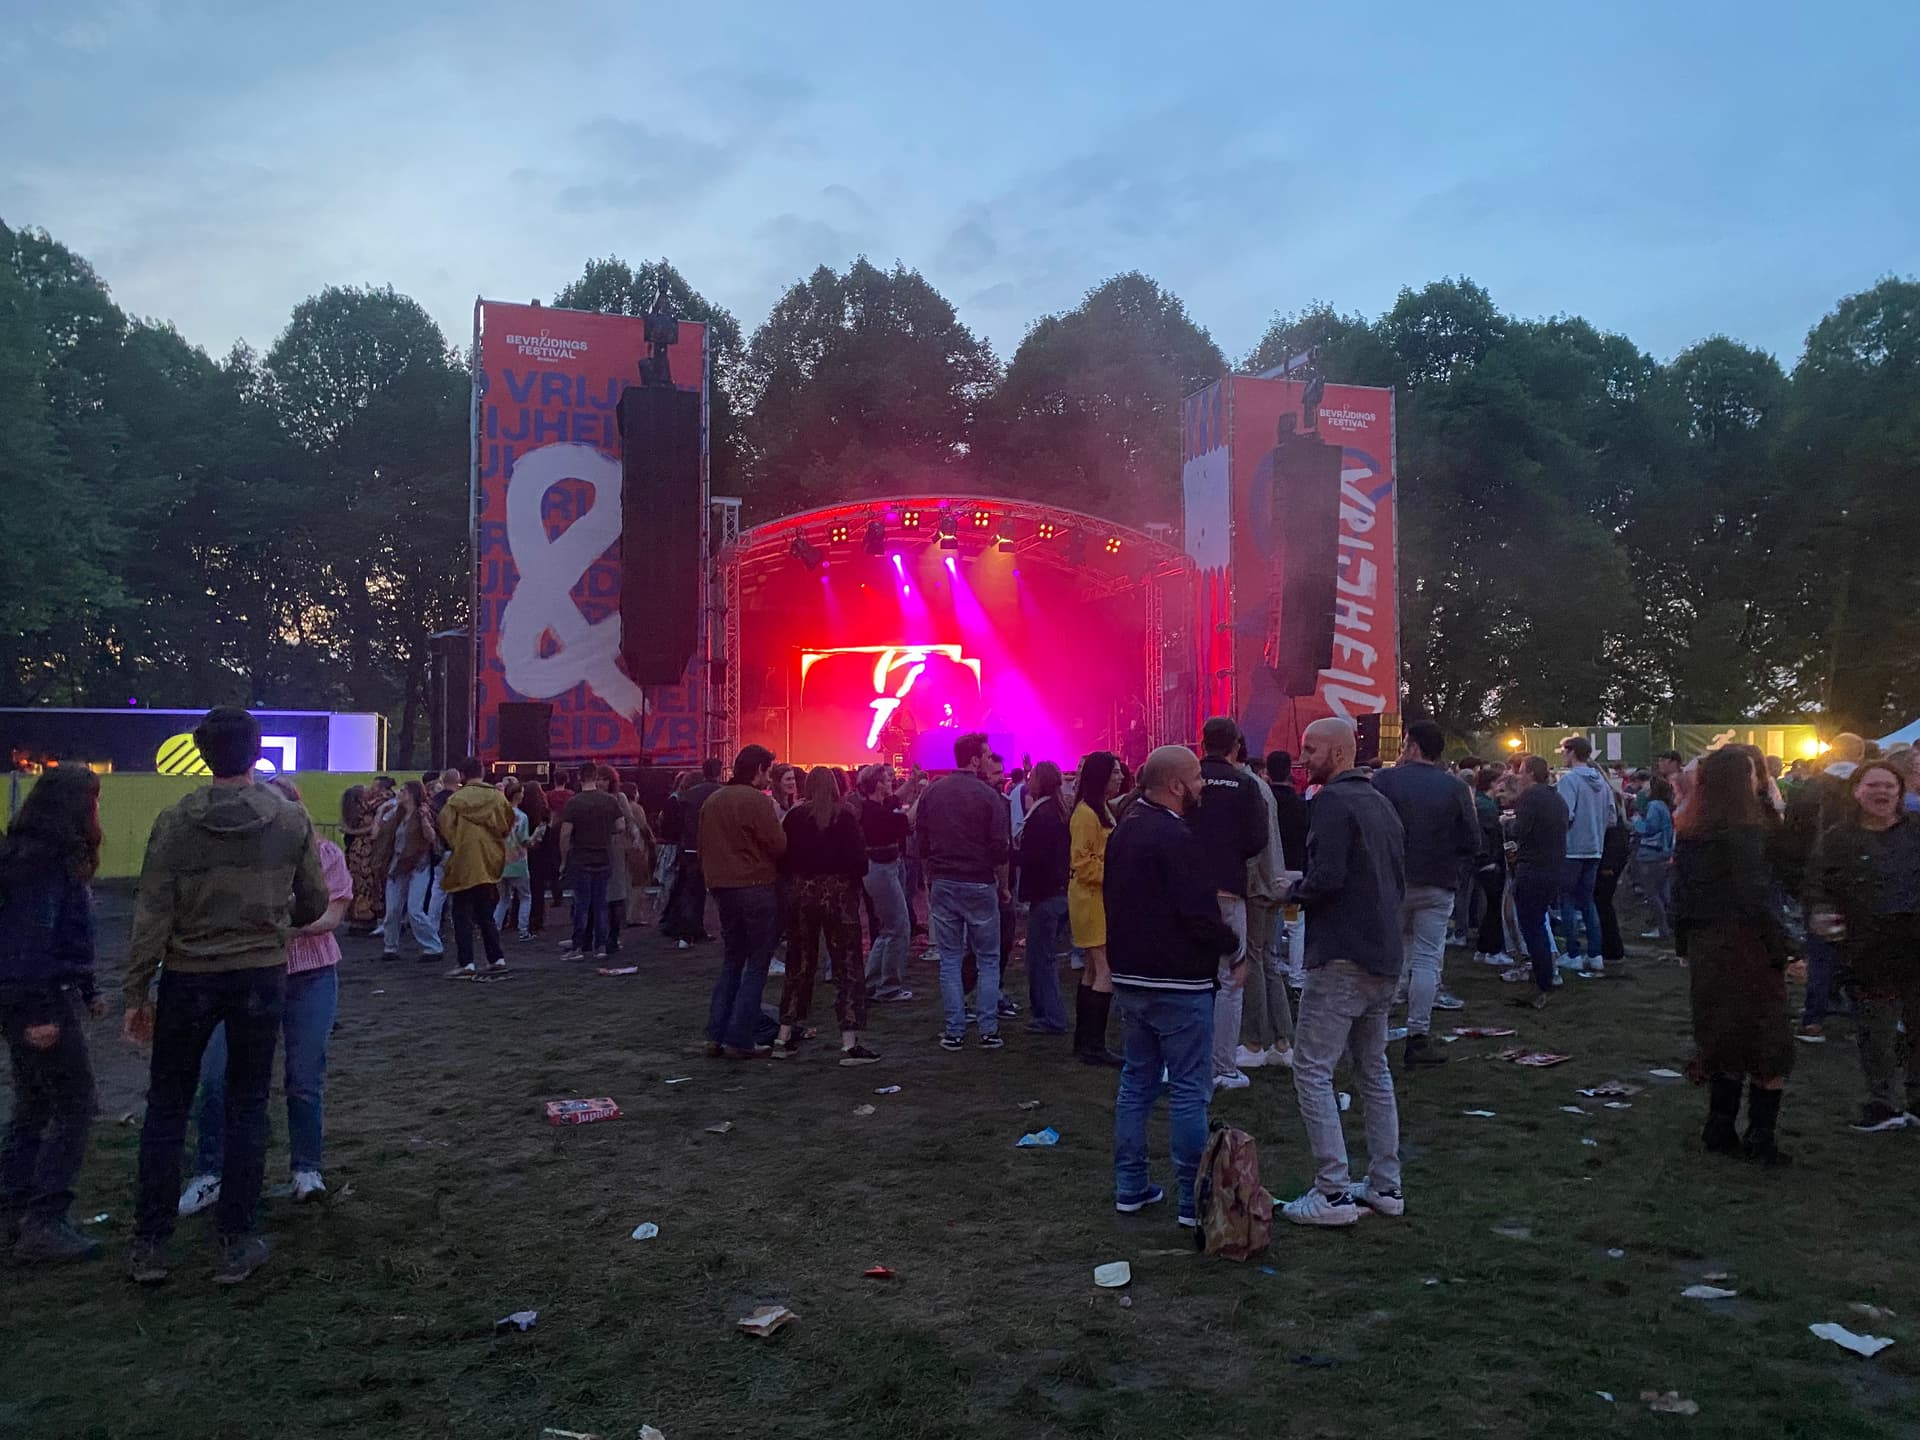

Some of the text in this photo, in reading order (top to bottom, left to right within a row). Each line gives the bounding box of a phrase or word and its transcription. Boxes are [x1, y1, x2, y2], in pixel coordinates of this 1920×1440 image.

[505, 334, 588, 351] BEVRIJDINGS
[518, 345, 577, 359] FESTIVAL
[502, 369, 626, 409] VRIJ
[1328, 417, 1368, 428] FESTIVAL
[1207, 778, 1239, 788] PAPER
